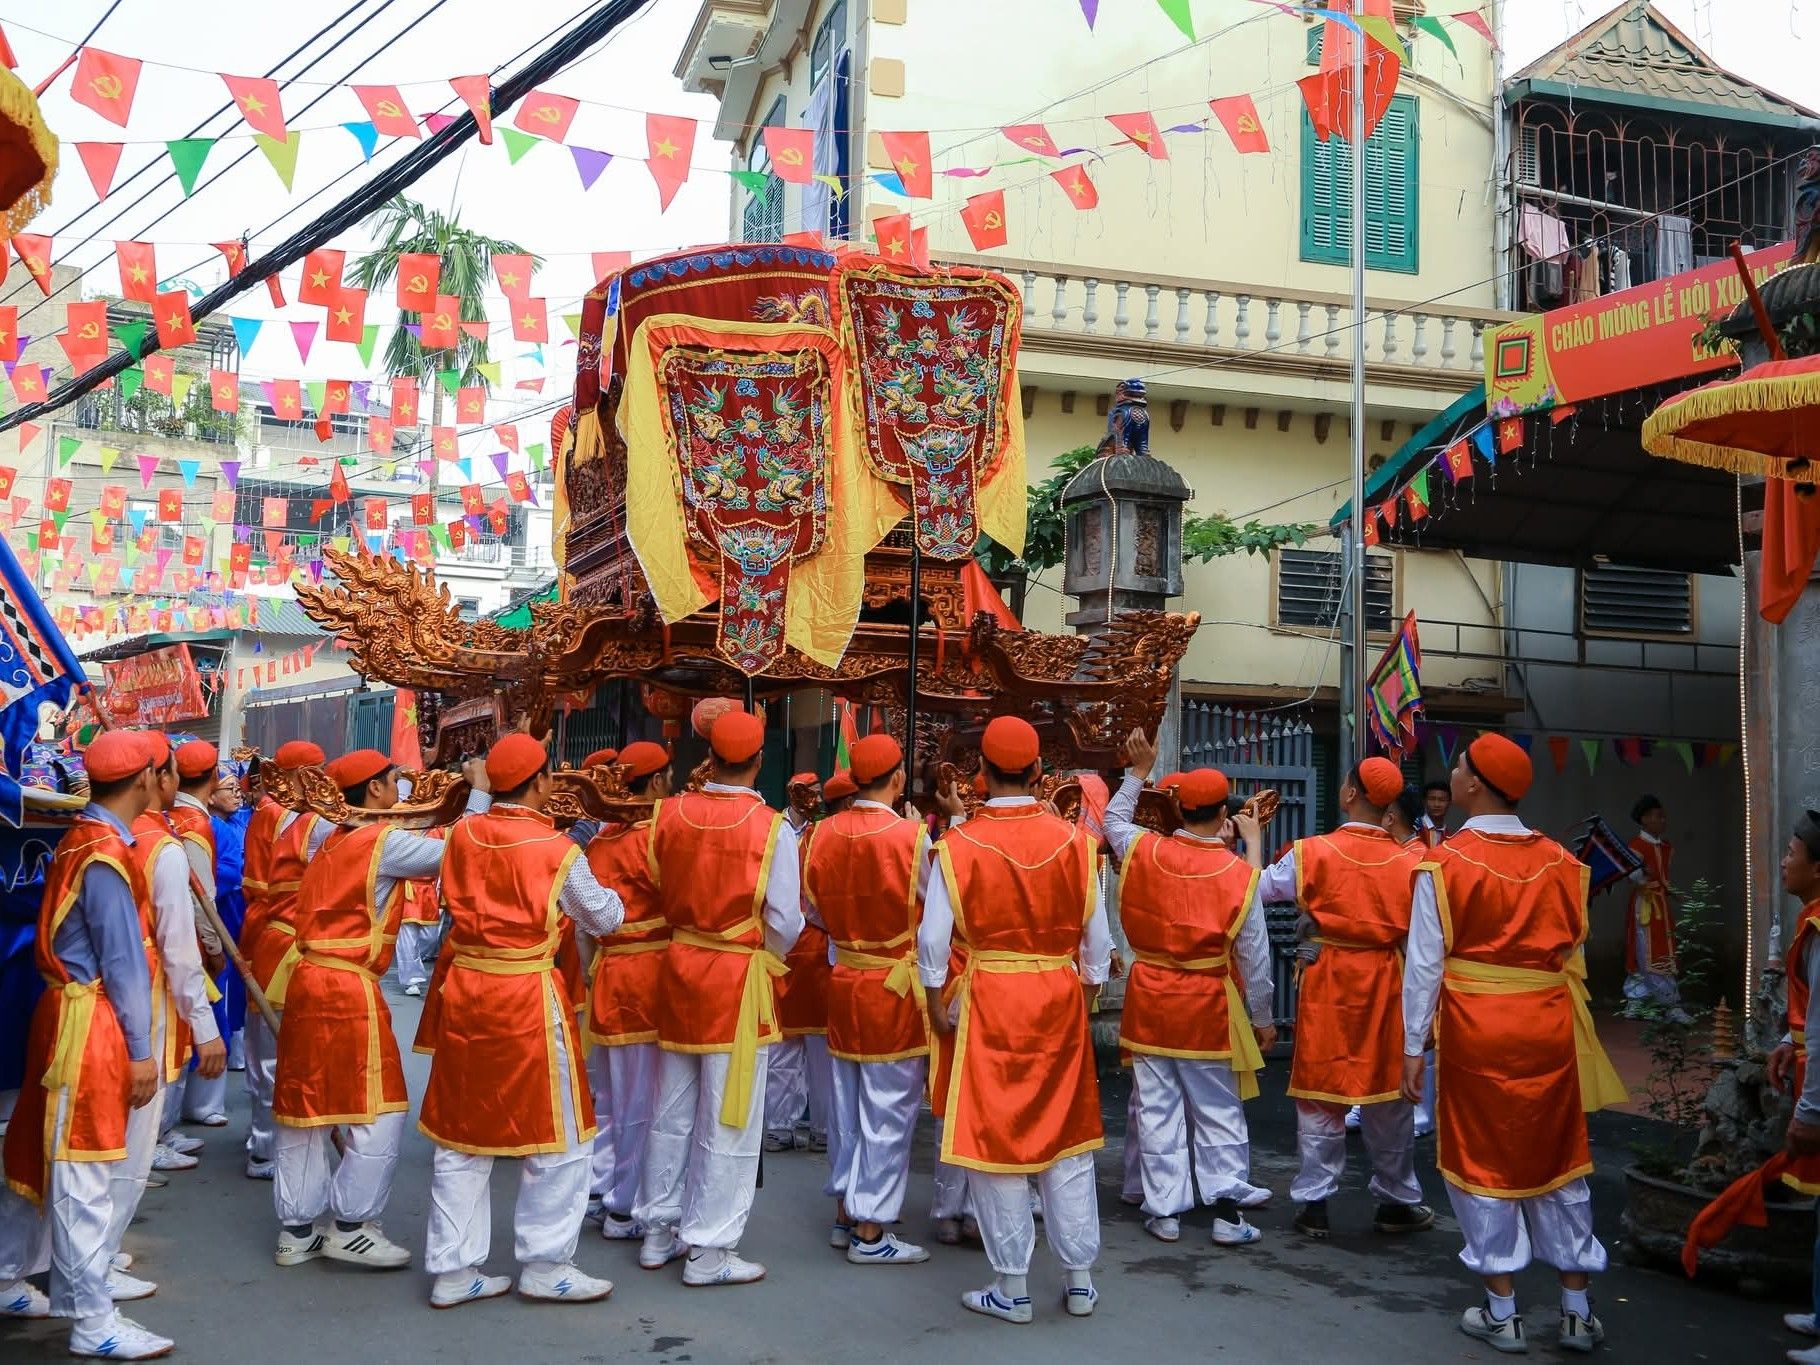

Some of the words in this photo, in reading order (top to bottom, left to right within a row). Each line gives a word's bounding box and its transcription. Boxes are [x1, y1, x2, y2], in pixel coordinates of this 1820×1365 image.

[1552, 315, 1594, 353] CHÀO
[1600, 300, 1650, 339] MỪNG
[1654, 281, 1675, 325] LỄ
[1680, 277, 1710, 320] HỘI
